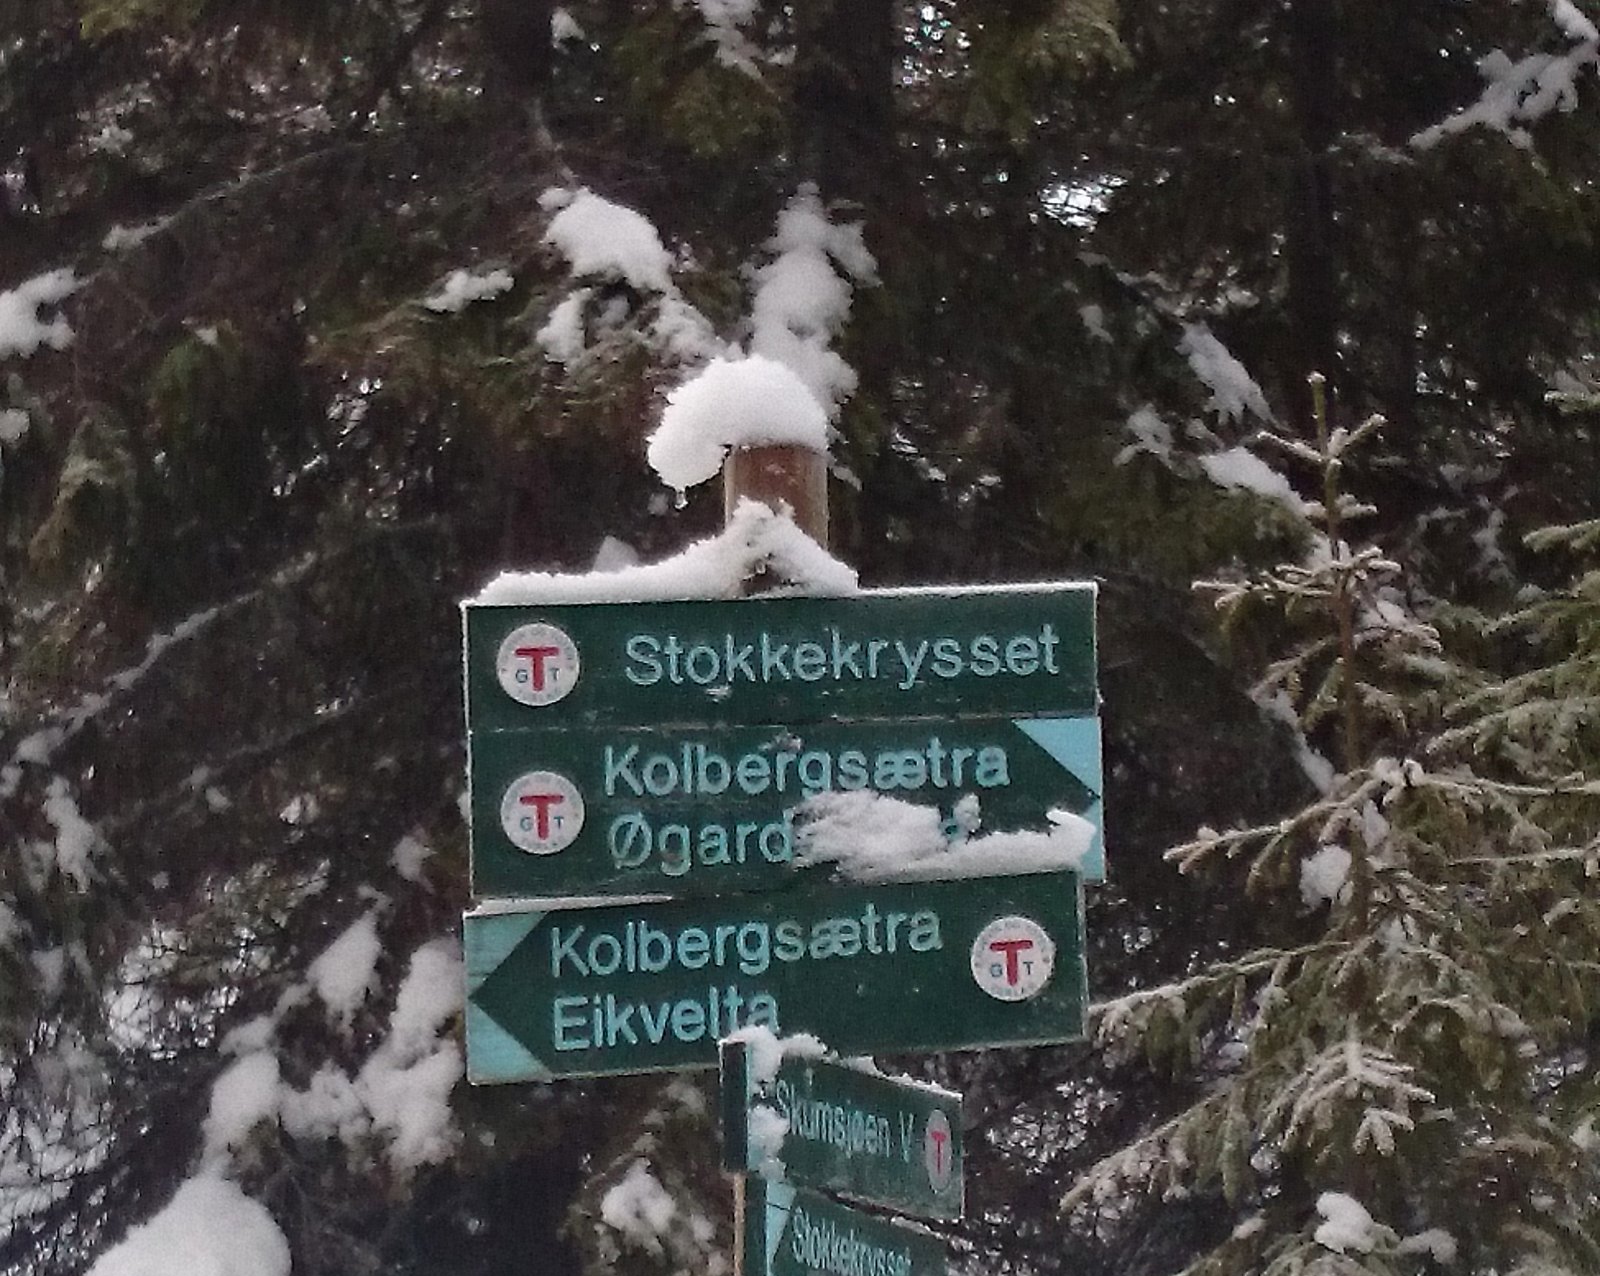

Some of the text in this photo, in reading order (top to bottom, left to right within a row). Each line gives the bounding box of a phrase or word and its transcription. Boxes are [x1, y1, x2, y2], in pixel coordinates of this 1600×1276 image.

[624, 622, 1061, 692] Stokkekrysset
[603, 735, 1012, 800] Kolbergsætra
[549, 902, 944, 977] Kolbergsætra
[553, 984, 781, 1051] Eikvelta
